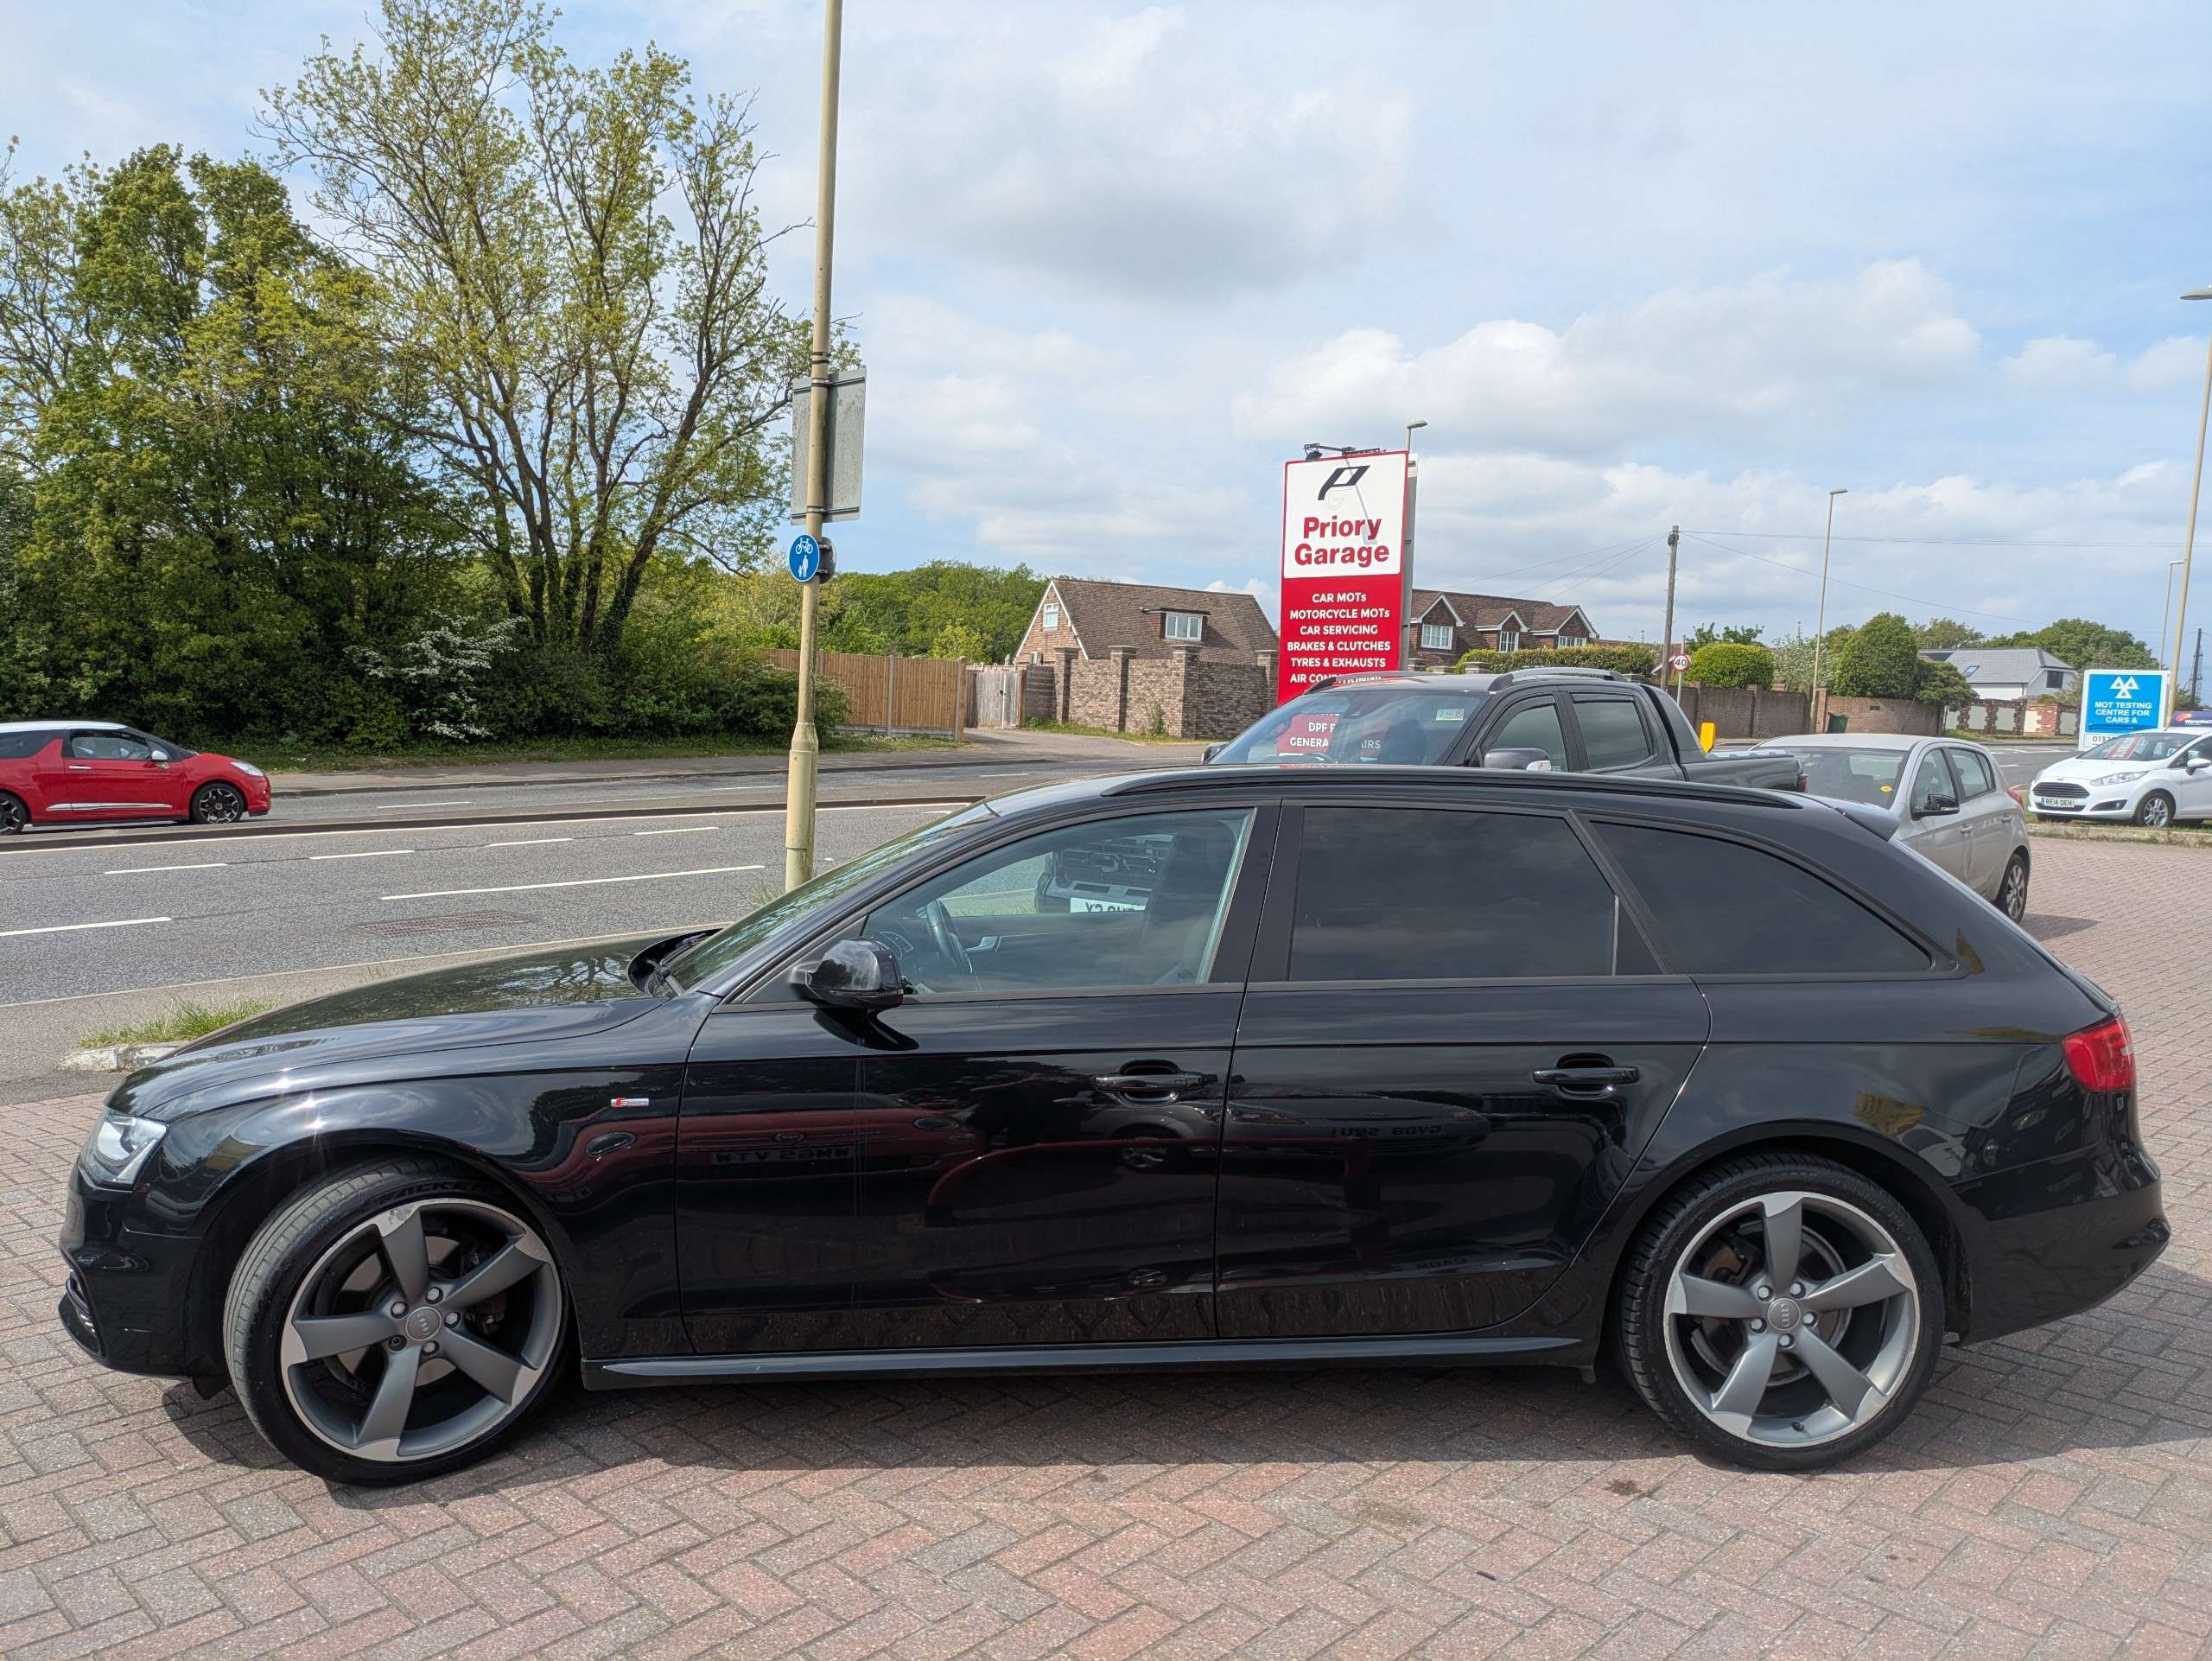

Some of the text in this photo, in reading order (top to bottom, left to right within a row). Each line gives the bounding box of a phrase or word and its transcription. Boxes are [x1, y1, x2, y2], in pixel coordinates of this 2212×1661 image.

[1303, 517, 1382, 541] Priory
[1294, 543, 1389, 568] Garage
[1312, 592, 1367, 603] CAR MOTs
[1289, 608, 1390, 620] MOTORCYCLE MOTs
[1300, 624, 1379, 636] CAR SERVICING
[1287, 640, 1391, 652] BRAKES & CLUTCHES
[1290, 657, 1386, 668] TYRES & EXHAUSTS
[1289, 673, 1307, 684] AIR
[1308, 722, 1327, 733] DPF
[1289, 736, 1329, 748] GENERA
